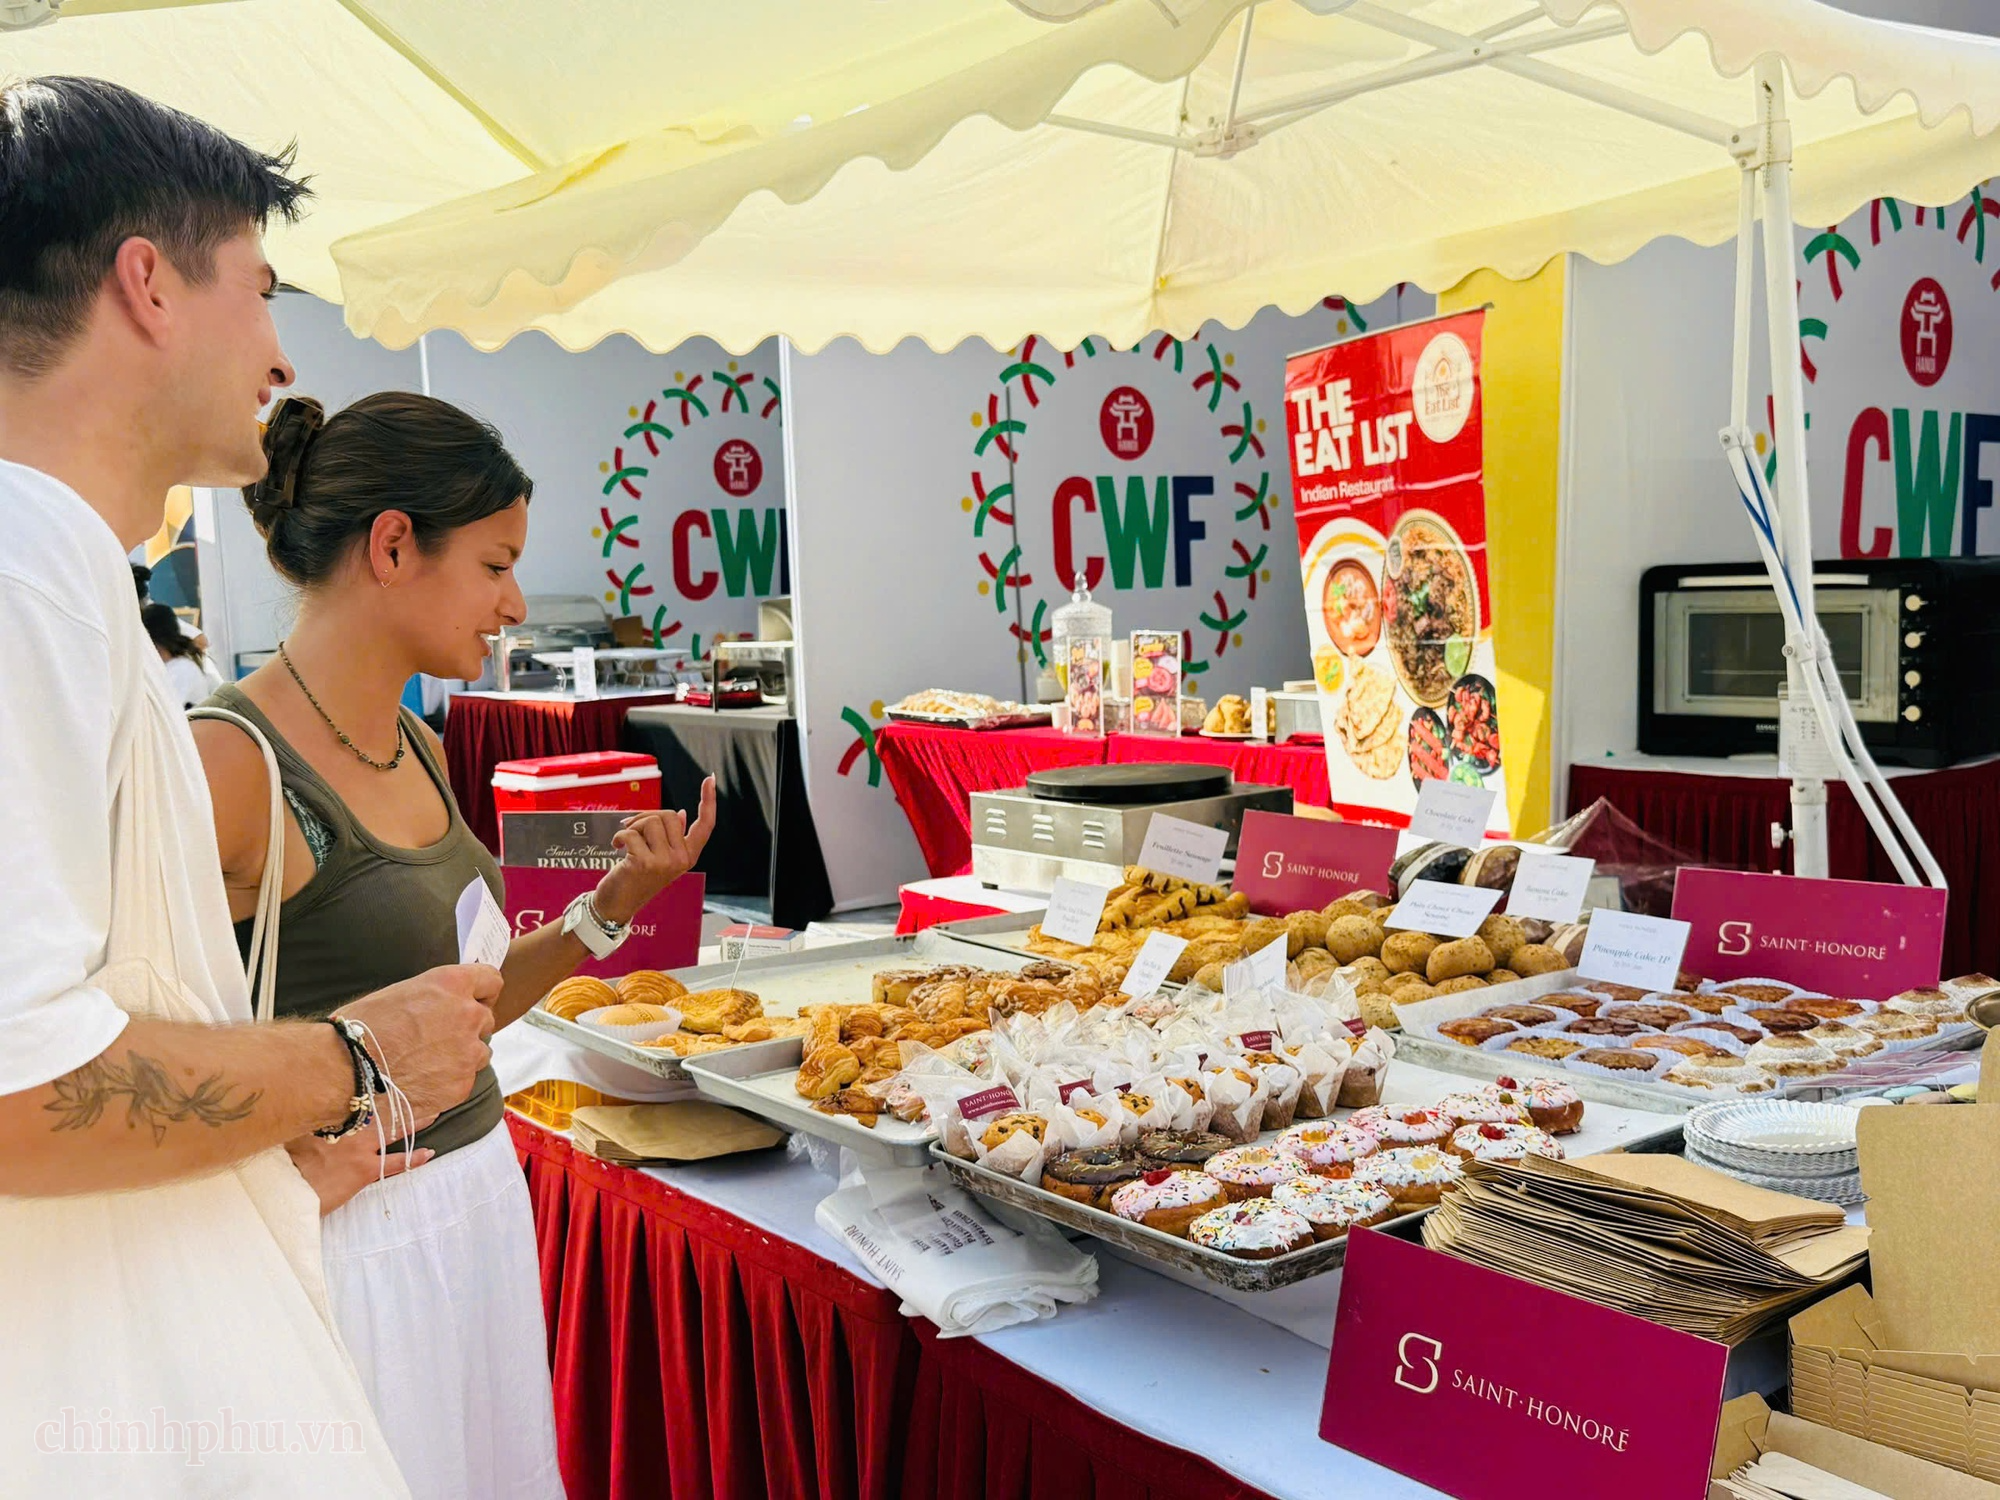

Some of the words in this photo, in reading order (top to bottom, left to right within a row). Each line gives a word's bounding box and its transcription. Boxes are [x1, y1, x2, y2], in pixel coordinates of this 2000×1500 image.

[1291, 378, 1354, 432] THE
[1295, 424, 1353, 476] EAT
[1360, 410, 1412, 466] LIST
[1301, 484, 1338, 503] Indian
[1338, 476, 1395, 499] Restaurant
[1840, 407, 2000, 560] CWF
[1052, 476, 1214, 593] CWF
[1634, 950, 1656, 963] Cake
